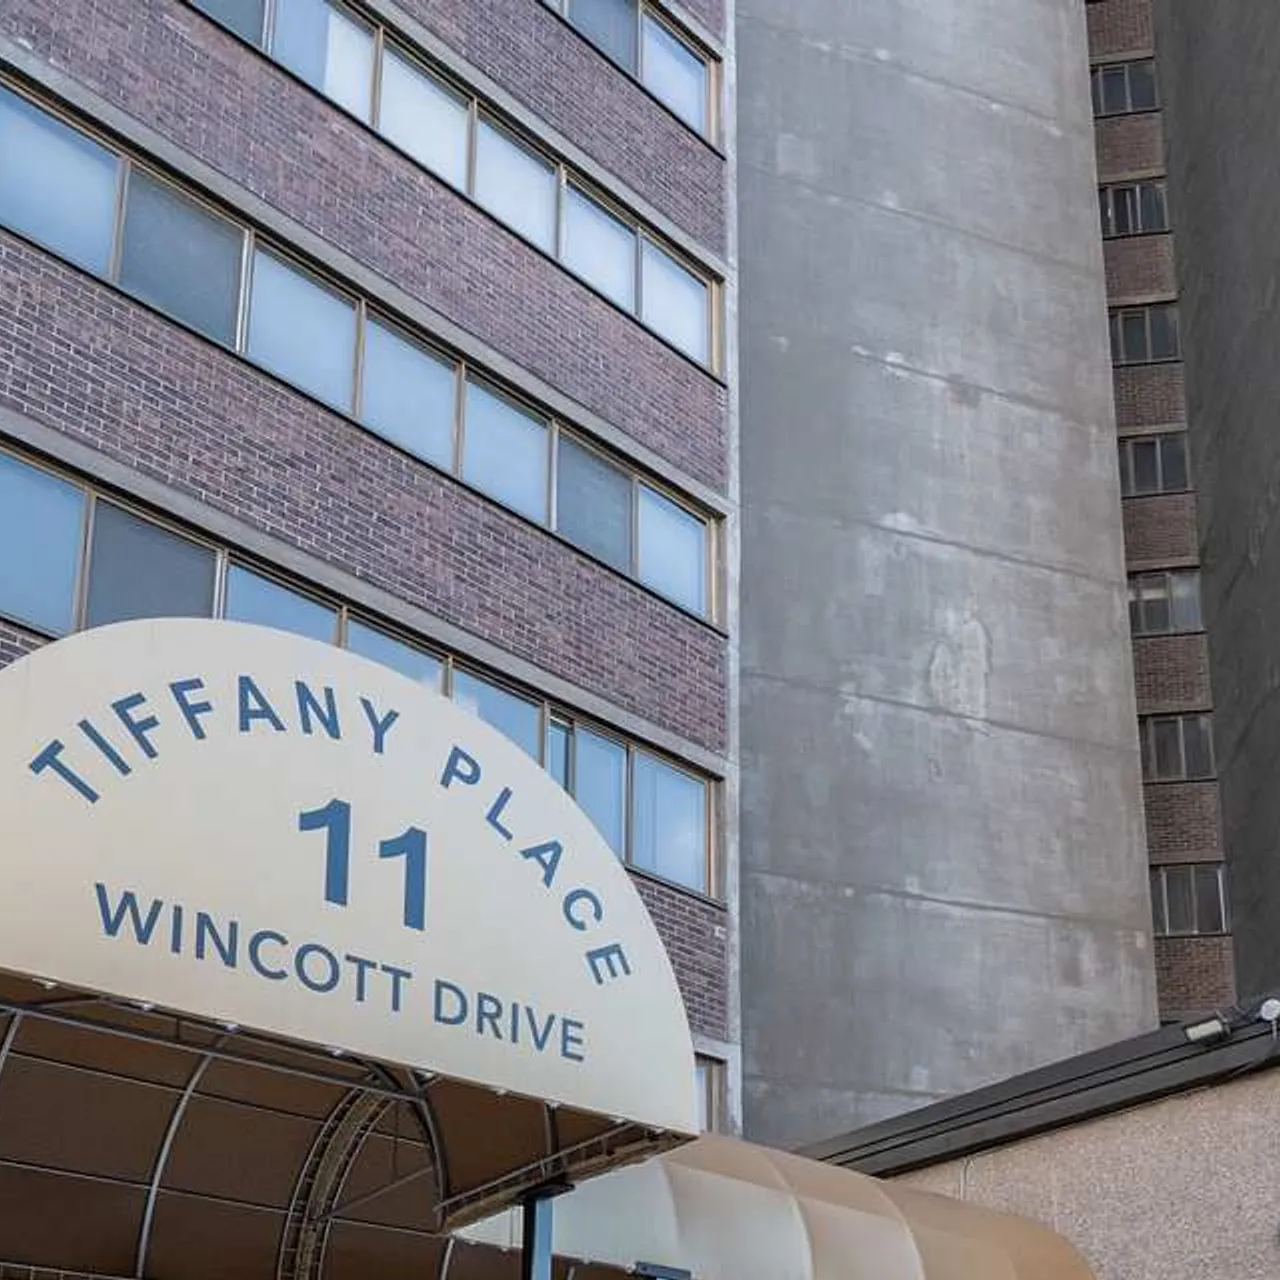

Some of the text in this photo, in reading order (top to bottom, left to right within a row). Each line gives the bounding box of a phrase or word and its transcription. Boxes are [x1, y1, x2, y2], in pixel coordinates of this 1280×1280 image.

[28, 673, 634, 985] TIFFANY PLACE
[293, 799, 431, 931] 11
[95, 882, 585, 1062] WINCOTT DRIVE
